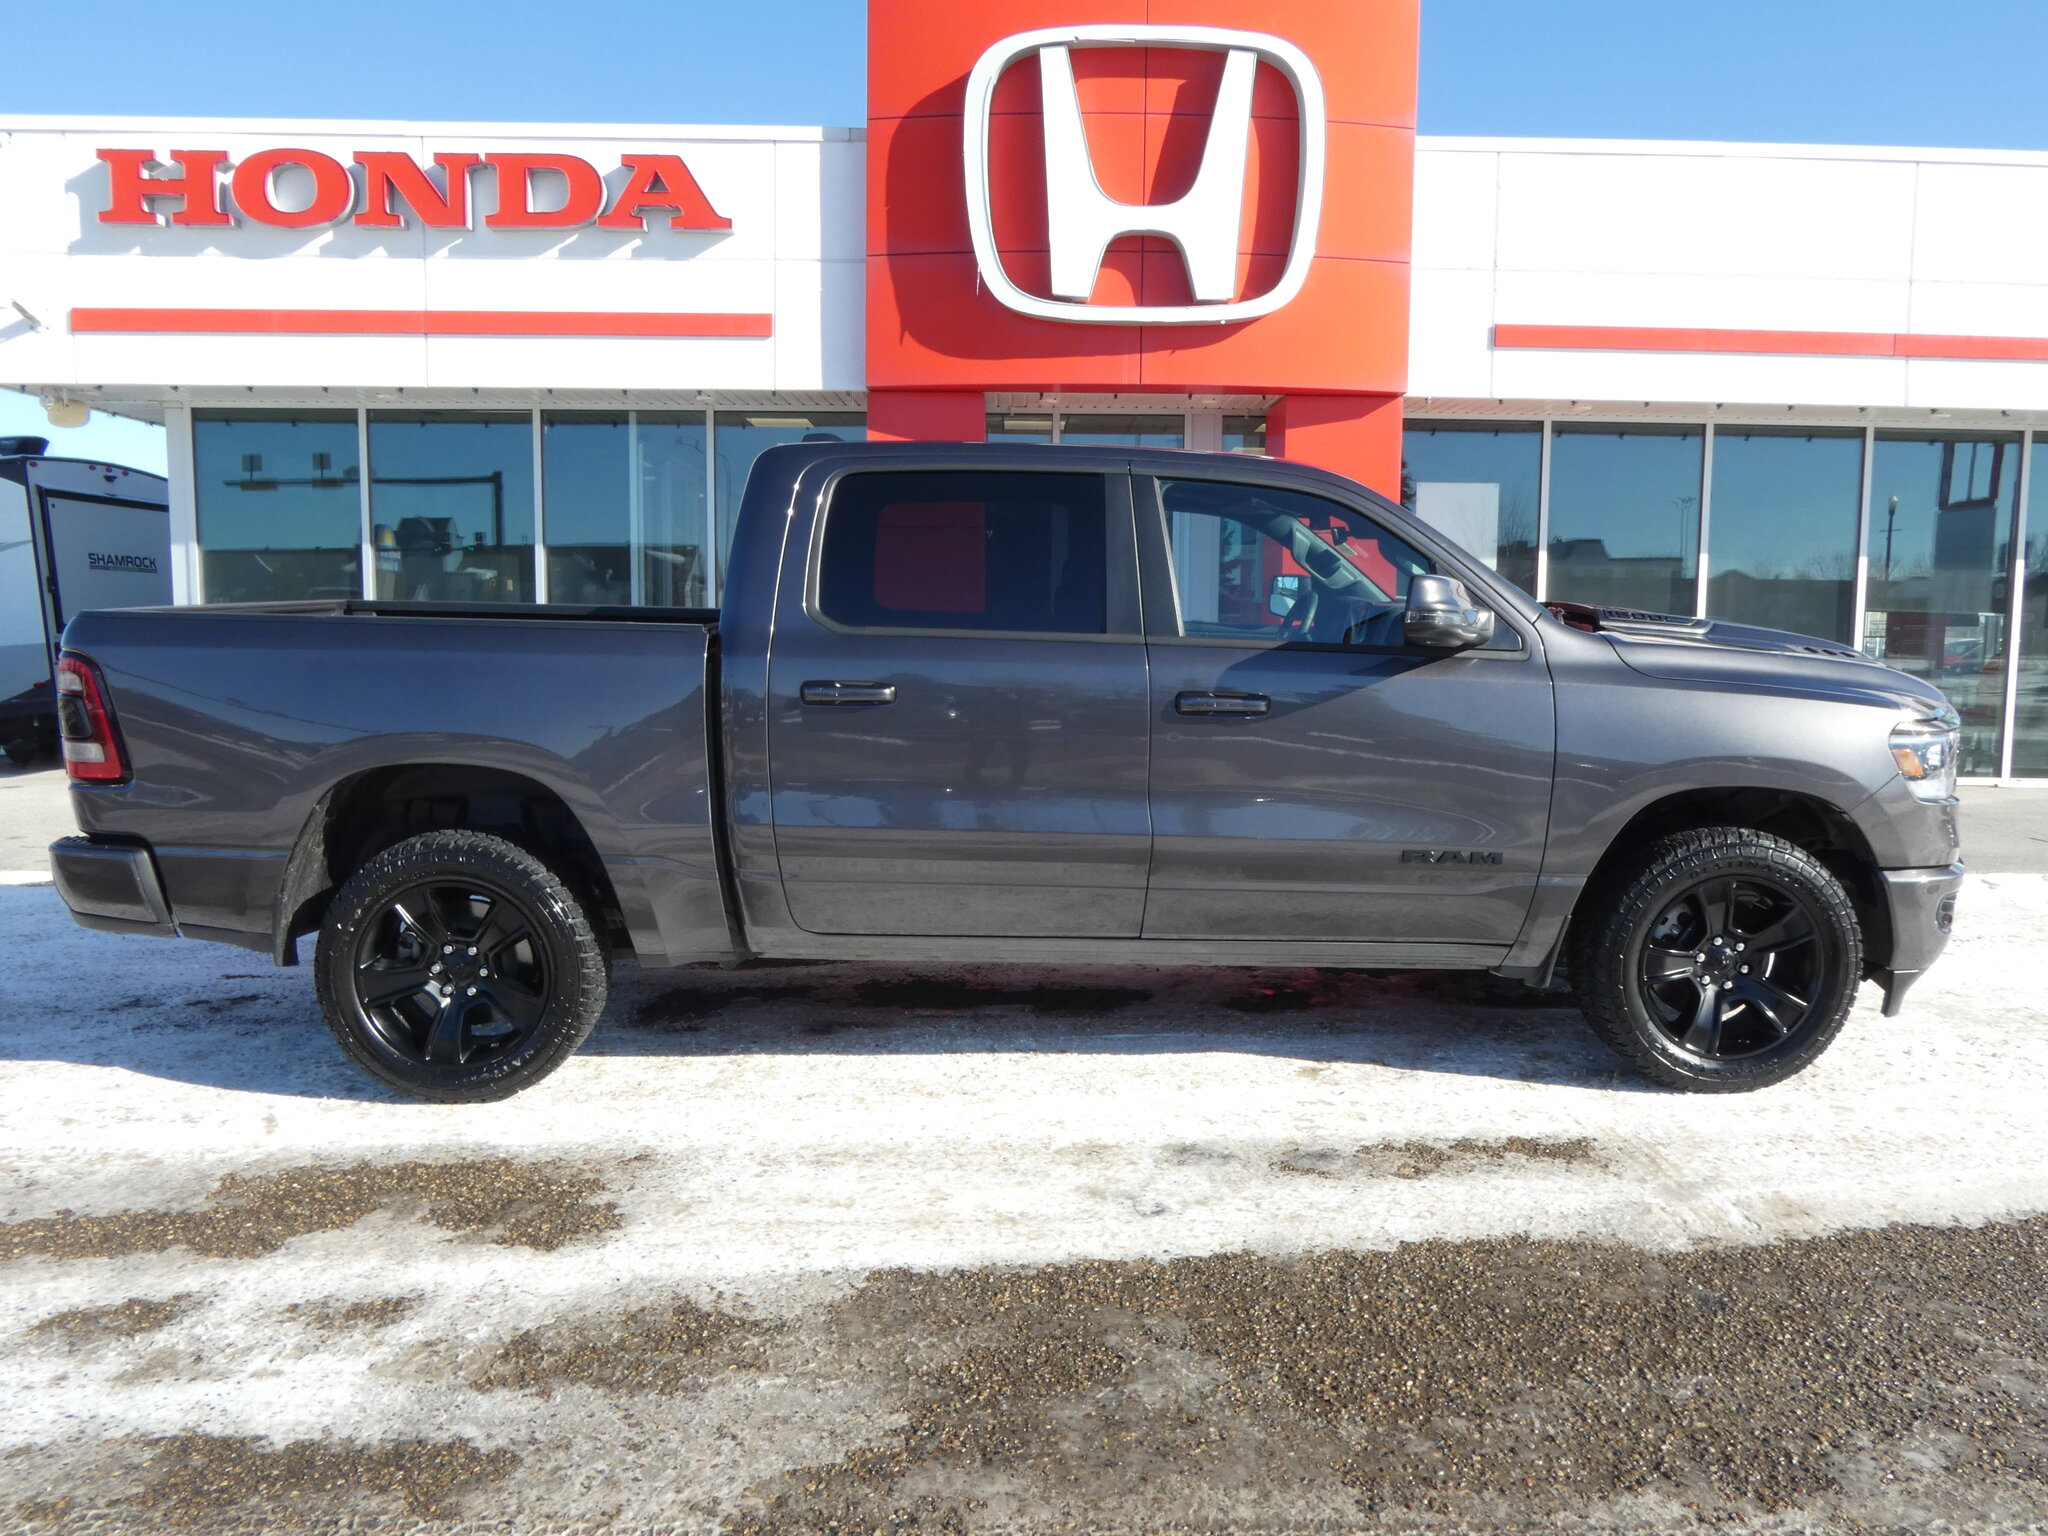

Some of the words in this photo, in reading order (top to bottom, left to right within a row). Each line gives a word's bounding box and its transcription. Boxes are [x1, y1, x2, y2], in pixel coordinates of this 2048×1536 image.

[95, 148, 733, 231] HONDA
[88, 553, 157, 568] SHAMROCK
[1400, 849, 1503, 864] RAM
